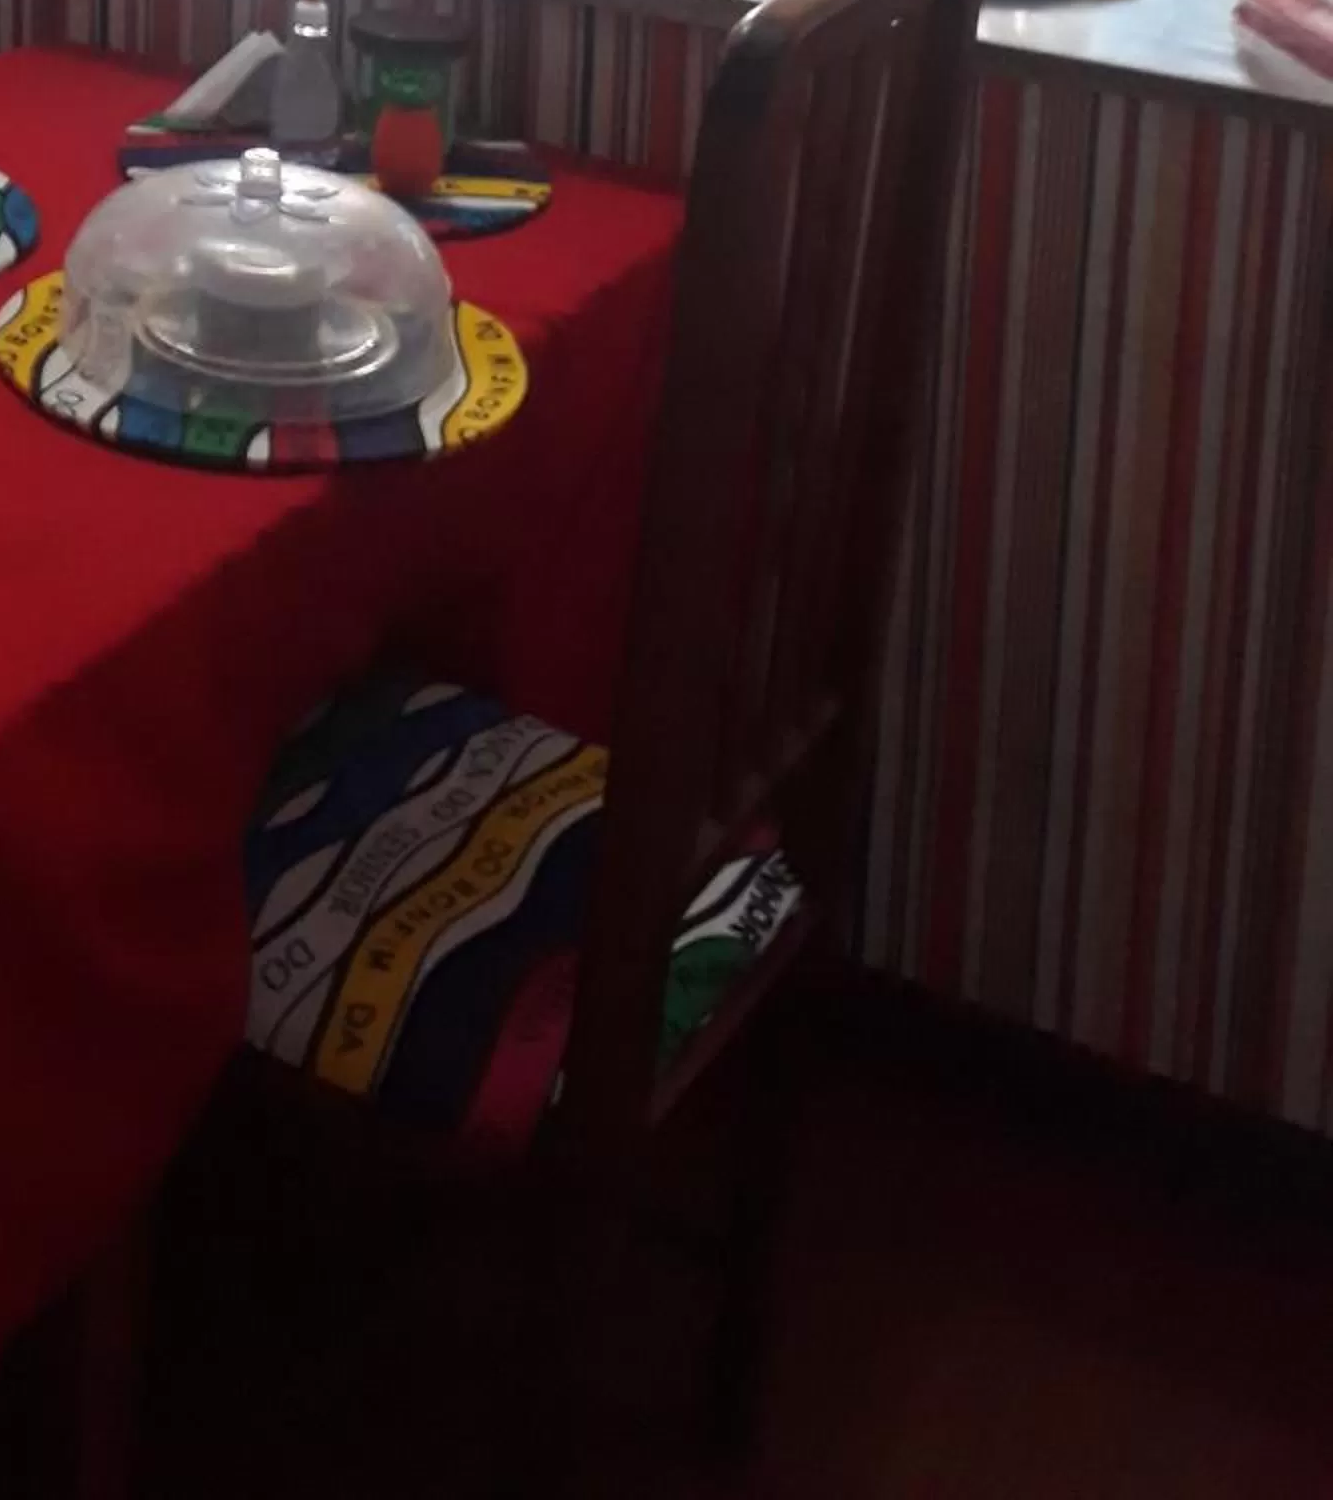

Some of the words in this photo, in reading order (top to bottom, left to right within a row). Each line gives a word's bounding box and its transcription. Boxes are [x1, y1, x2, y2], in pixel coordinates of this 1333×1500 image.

[471, 838, 514, 876] DO
[258, 937, 316, 991] DO
[336, 1001, 378, 1054] DA
